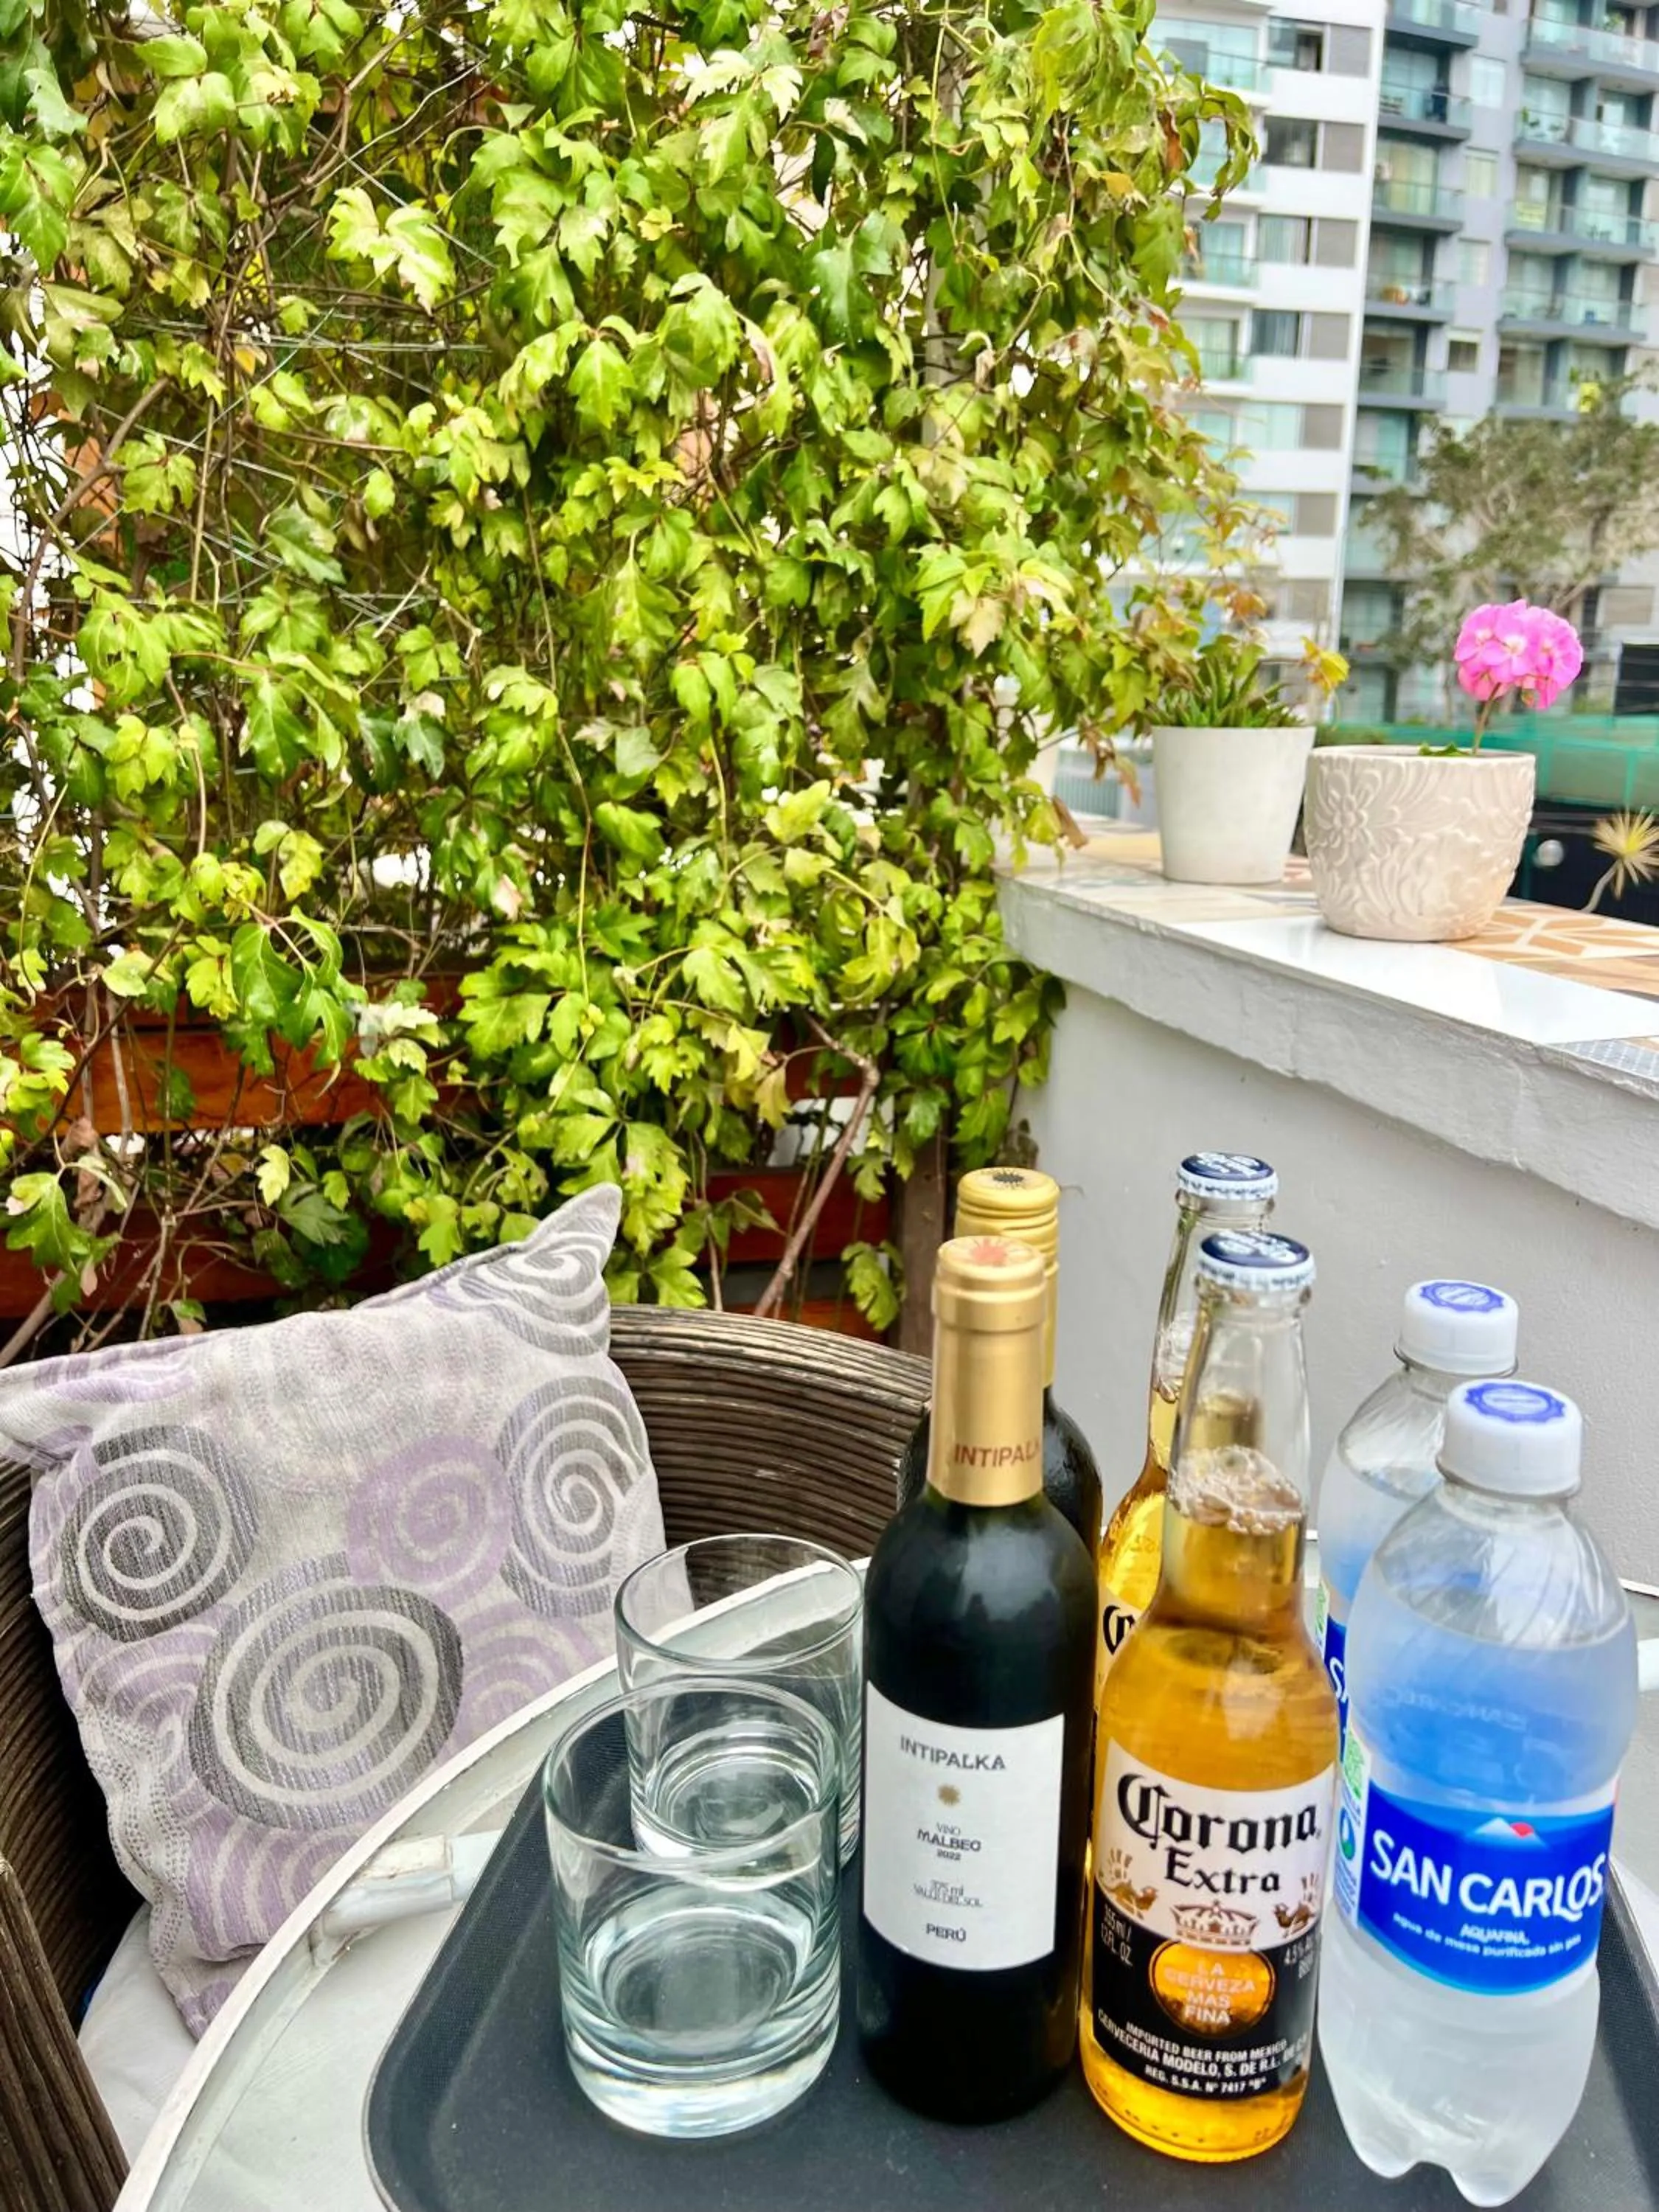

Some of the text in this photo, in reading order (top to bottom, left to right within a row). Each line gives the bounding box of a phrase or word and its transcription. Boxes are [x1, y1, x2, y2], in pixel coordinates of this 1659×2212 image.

[900, 1734, 1006, 1770] INTIPALKA
[1117, 1773, 1318, 1854] Corona
[1164, 1846, 1281, 1894] Extra
[1370, 1829, 1453, 1906] SAN
[1458, 1851, 1607, 1923] CARLOS
[1164, 1966, 1256, 1994] CERVEZA
[1197, 1958, 1225, 1977] LA
[1184, 2004, 1232, 2026] FINA
[1186, 1990, 1232, 2011] MAS
[1125, 2020, 1180, 2056] IMPORTED
[1182, 2045, 1213, 2062] BEER
[1214, 2048, 1248, 2063] FROM
[1239, 2062, 1258, 2076] DE
